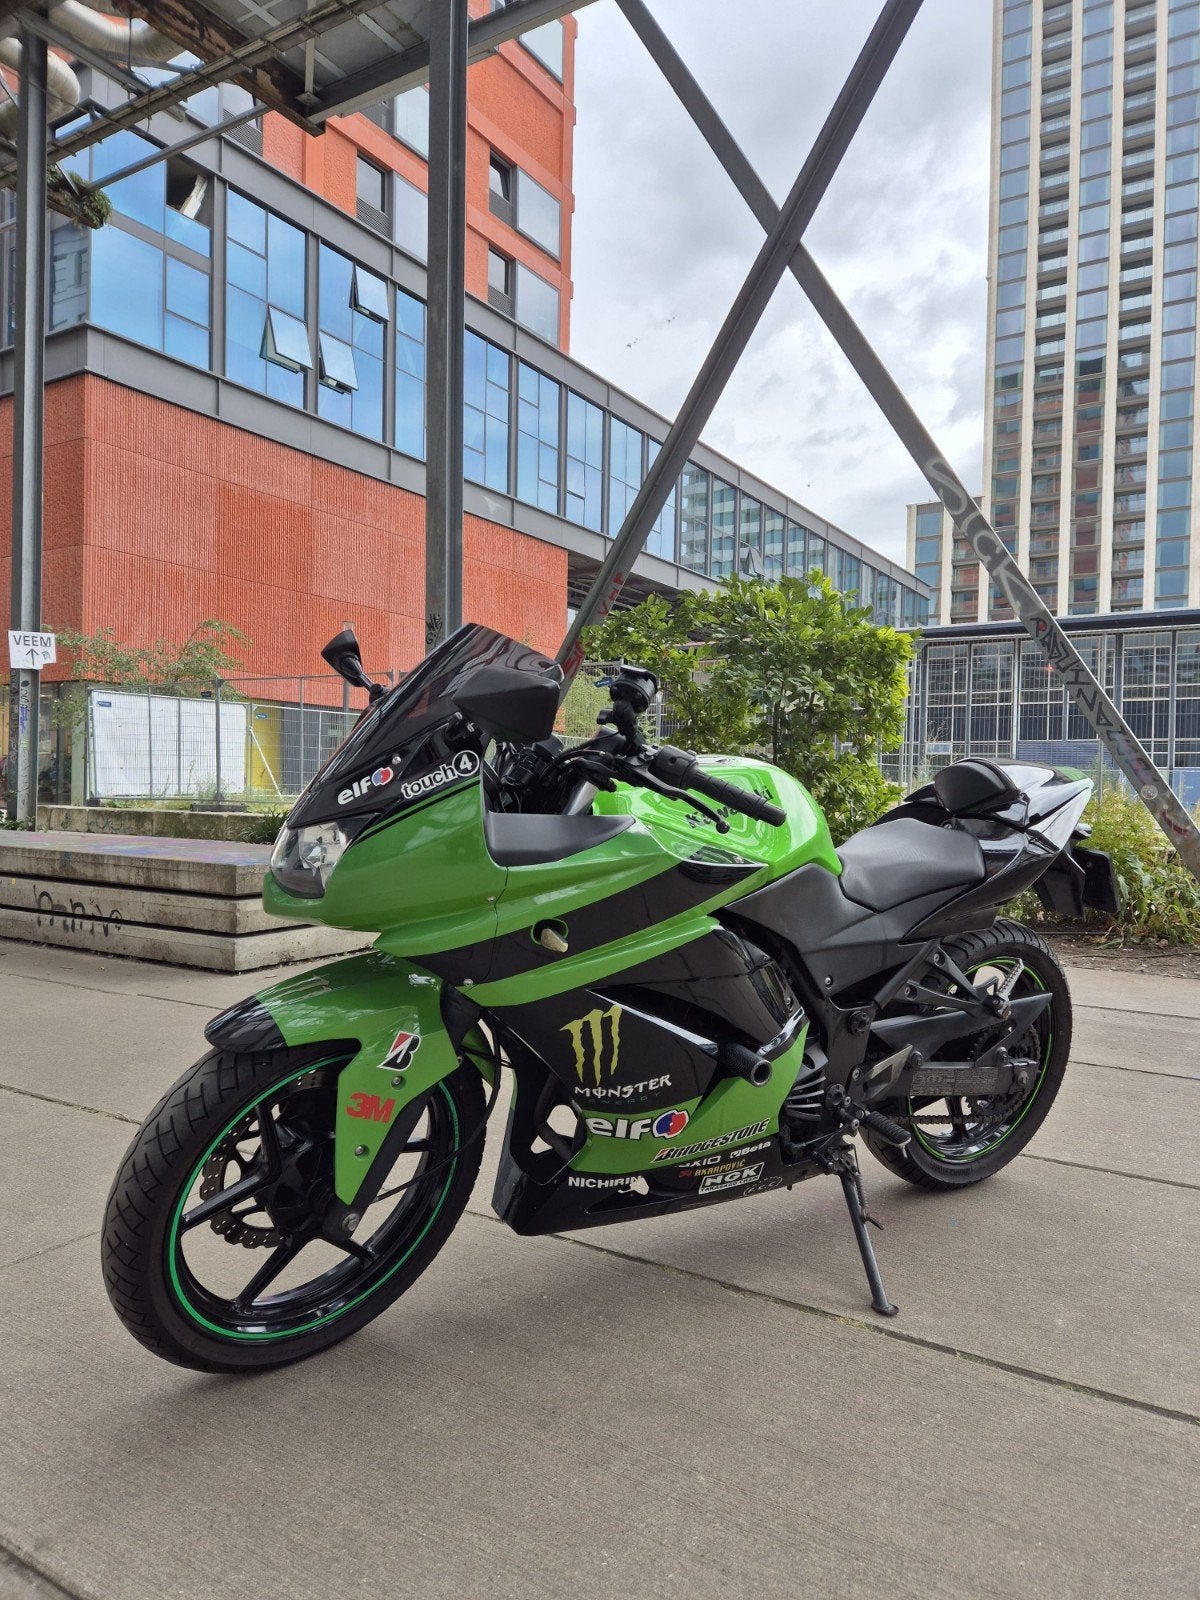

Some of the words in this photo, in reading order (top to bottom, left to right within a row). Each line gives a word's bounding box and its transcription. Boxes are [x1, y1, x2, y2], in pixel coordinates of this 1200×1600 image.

[13, 634, 52, 648] VEEM
[337, 776, 372, 805] elf
[574, 1074, 673, 1098] MONSTER
[346, 1092, 396, 1123] 3M
[586, 1117, 653, 1141] elf
[651, 1118, 771, 1163] BRIDGESTONE
[705, 1166, 760, 1187] NGK
